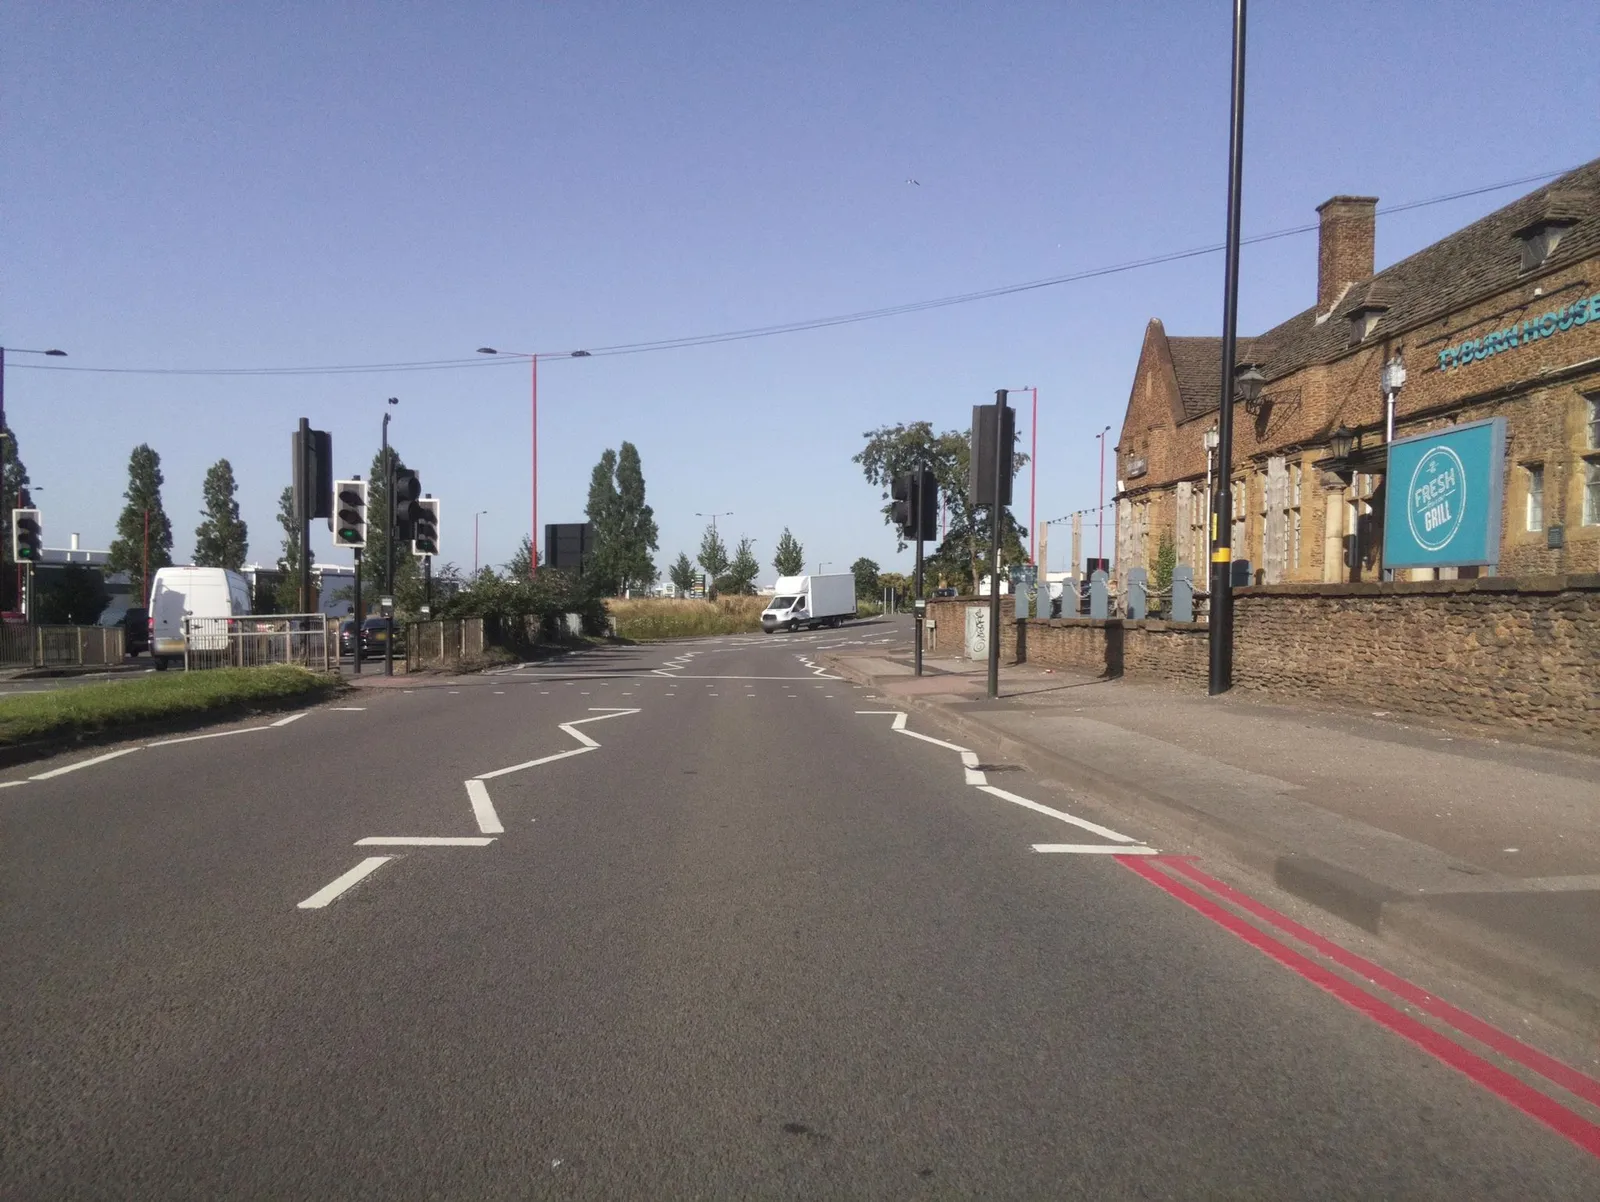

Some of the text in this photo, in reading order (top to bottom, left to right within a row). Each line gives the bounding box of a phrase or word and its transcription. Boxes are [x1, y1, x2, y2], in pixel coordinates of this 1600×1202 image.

[1439, 293, 1600, 371] TYBURN HOUSE
[1415, 468, 1455, 507] FRESH
[1424, 501, 1452, 532] GRILL
